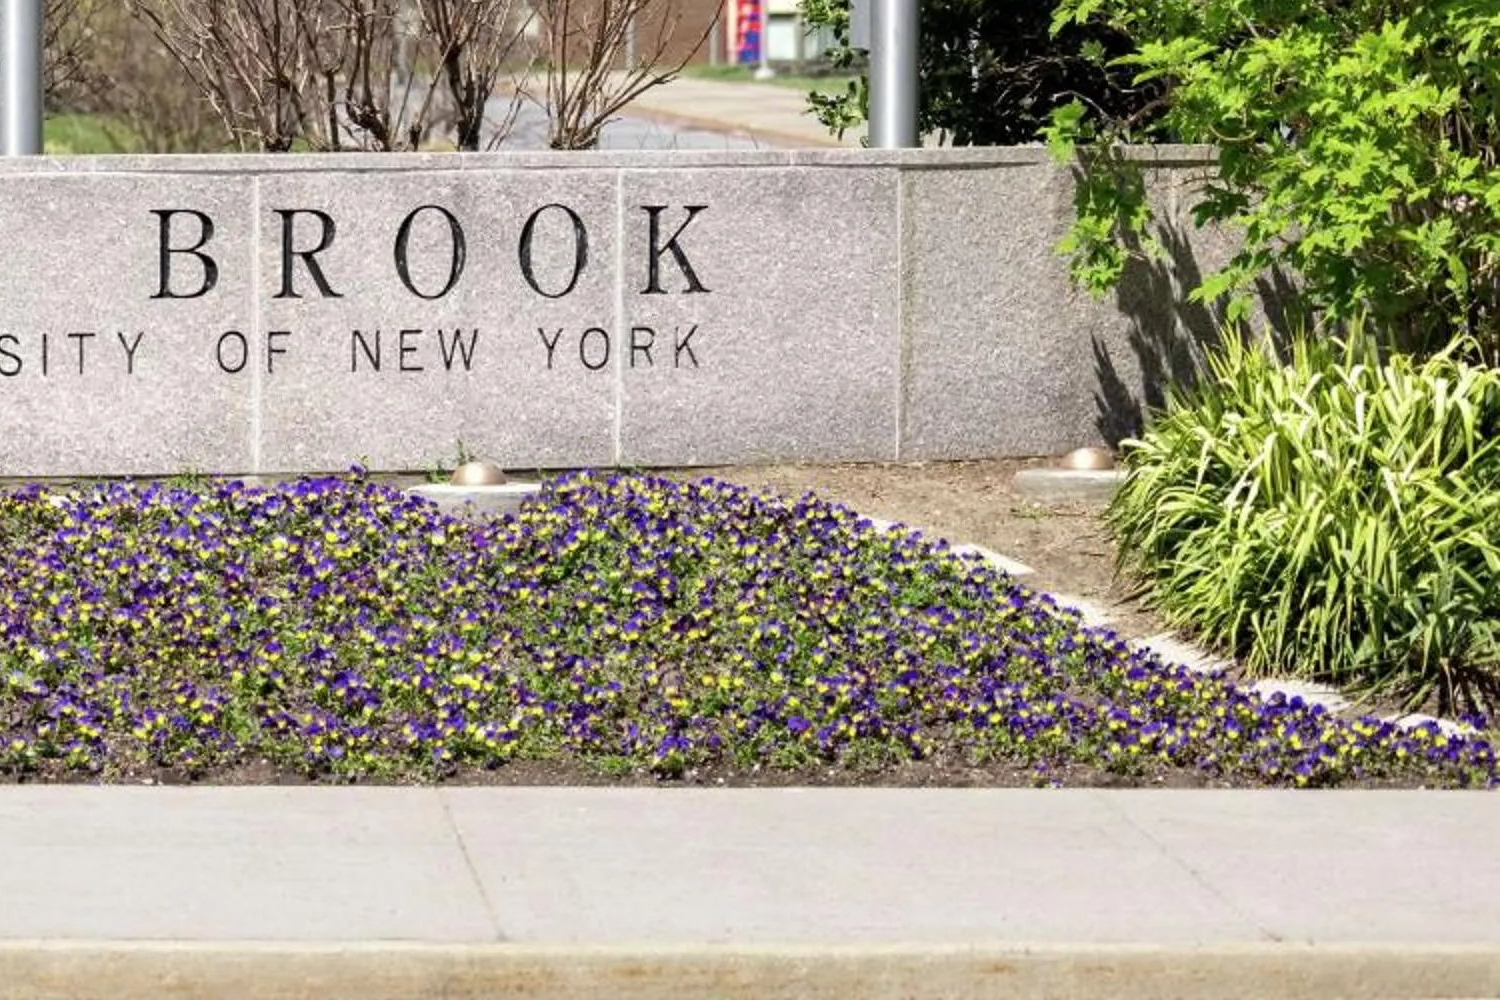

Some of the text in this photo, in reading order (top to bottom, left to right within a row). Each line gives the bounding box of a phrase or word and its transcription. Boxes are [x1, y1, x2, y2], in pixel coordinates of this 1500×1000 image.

[148, 202, 713, 300] BROOK
[215, 328, 292, 374] OF
[351, 328, 480, 373] NEW
[537, 325, 700, 371] YORK
